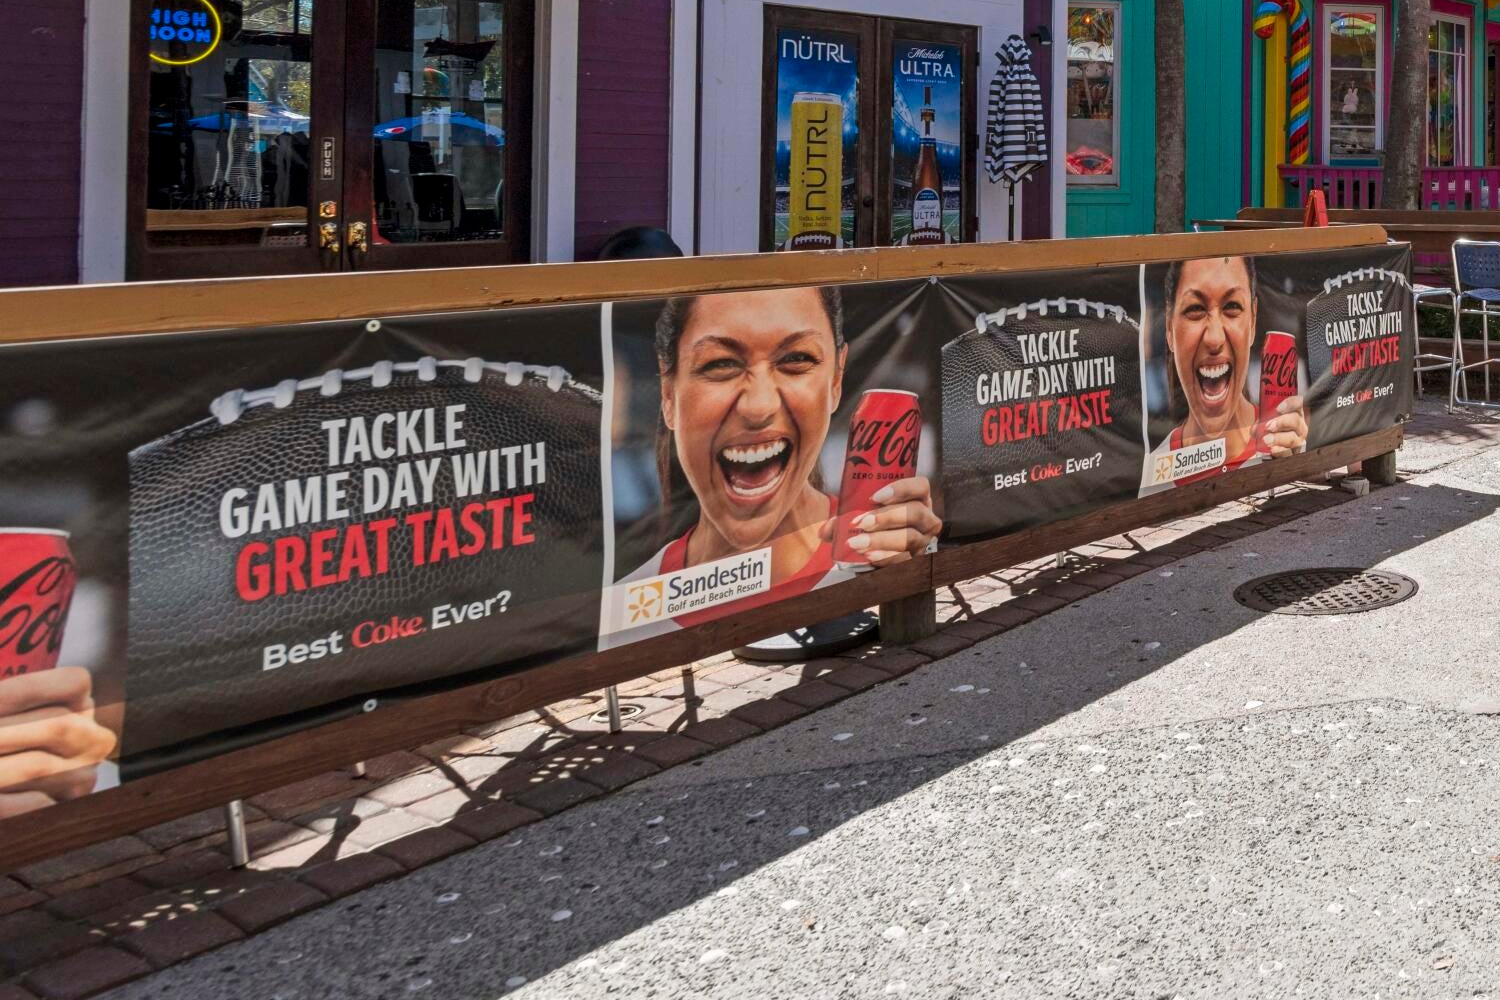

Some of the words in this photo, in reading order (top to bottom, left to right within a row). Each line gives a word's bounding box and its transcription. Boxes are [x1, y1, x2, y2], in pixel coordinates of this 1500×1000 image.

[782, 35, 853, 64] NÜTRL
[900, 60, 954, 78] ULTRA
[324, 141, 332, 175] PUSH
[801, 110, 829, 212] NÜTRL
[914, 211, 940, 220] ULTRA
[1347, 290, 1384, 316] TACKLE
[1325, 319, 1357, 346] GAME
[1358, 315, 1378, 340] DAY
[1379, 311, 1402, 335] WITH
[1017, 329, 1080, 365] TACKLE
[1332, 343, 1368, 376] GREAT
[1370, 336, 1400, 367] TASTE
[976, 368, 1034, 405] GAME
[1038, 363, 1069, 396] DAY
[1072, 356, 1116, 390] WITH
[1336, 393, 1355, 408] Best
[1373, 382, 1394, 399] Ever?
[321, 403, 466, 467] TACKLE
[982, 400, 1054, 446] GREAT
[1058, 389, 1112, 432] TASTE
[994, 468, 1028, 491] Best
[1030, 462, 1063, 481] Coke
[1065, 452, 1103, 474] Ever?
[1173, 468, 1184, 478] Golf
[1184, 466, 1193, 475] and
[1193, 464, 1207, 473] Beach
[1174, 443, 1223, 469] Sandestin
[219, 471, 350, 539] GAME
[363, 457, 442, 514] DAY
[451, 441, 546, 498] WITH
[852, 472, 873, 480] ZERO
[235, 517, 397, 601] GREAT
[405, 493, 535, 568] TASTE
[668, 557, 764, 601] Sandestin
[667, 598, 687, 614] Golf
[689, 595, 706, 607] and
[708, 587, 734, 602] Beach
[736, 580, 763, 593] Resort
[262, 630, 343, 672] Best
[351, 616, 426, 649] Coke
[431, 590, 512, 631] Ever?
